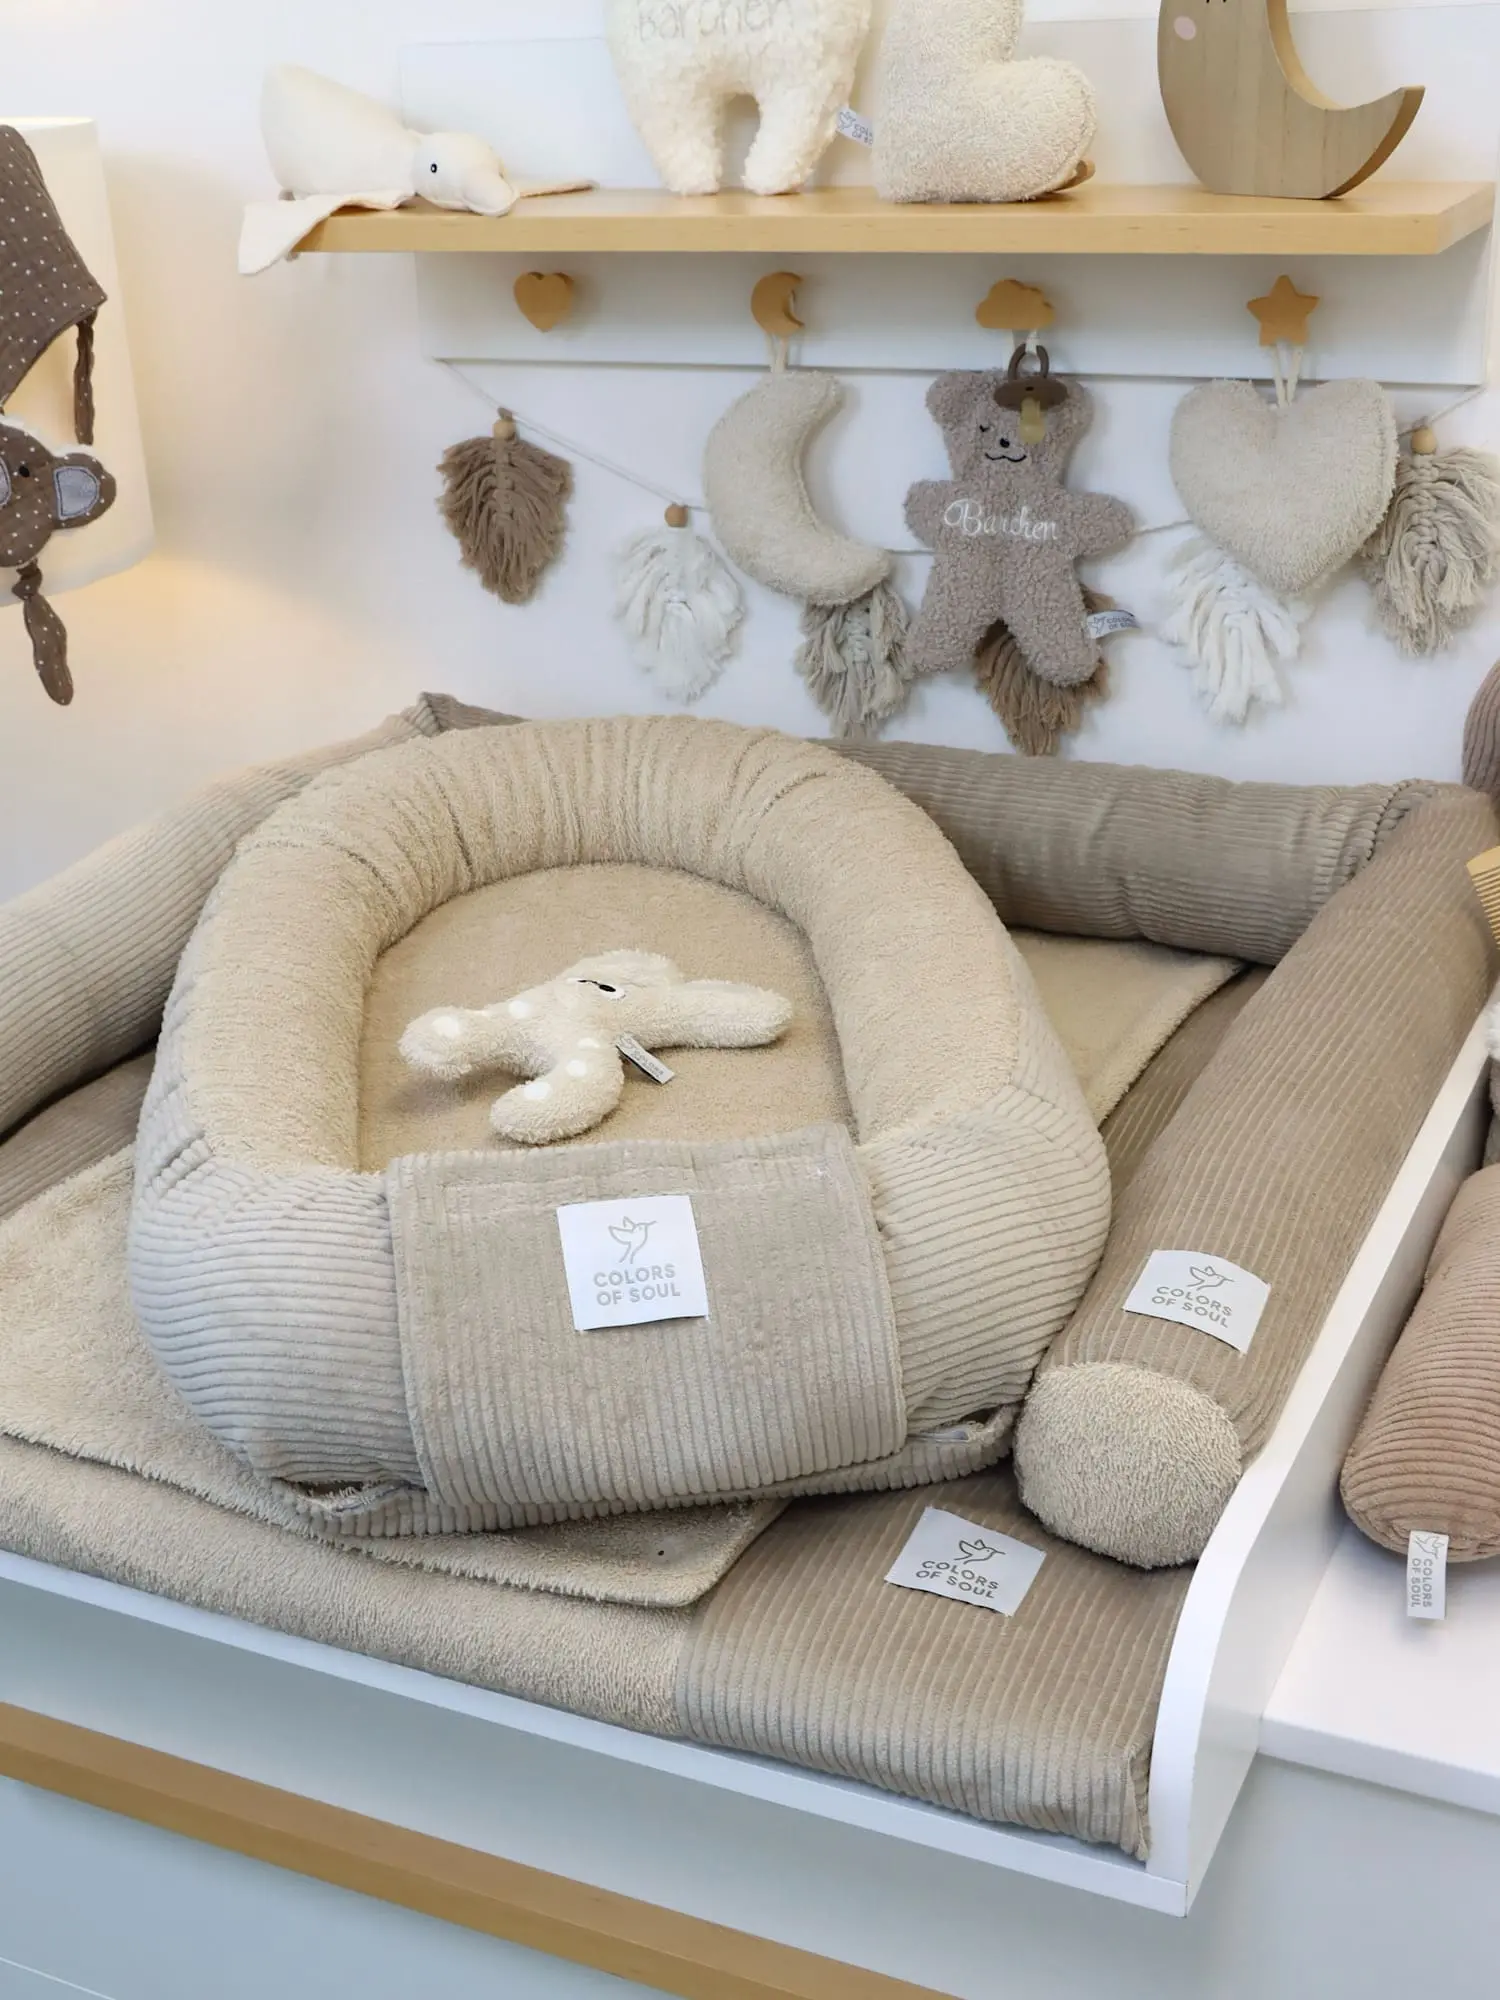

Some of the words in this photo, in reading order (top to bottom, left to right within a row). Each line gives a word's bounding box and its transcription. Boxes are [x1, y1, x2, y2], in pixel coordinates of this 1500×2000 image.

[592, 1263, 677, 1288] COLORS
[596, 1289, 624, 1307] OF
[629, 1281, 681, 1304] SOUL
[1155, 1285, 1233, 1317] COLORS
[1150, 1295, 1177, 1307] OF
[1180, 1302, 1229, 1329] SOUL
[921, 1560, 1000, 1590] COLORS
[1412, 1557, 1422, 1574] OF
[915, 1570, 943, 1580] OF
[946, 1576, 996, 1599] SOUL
[1410, 1576, 1422, 1608] SOUL
[1422, 1558, 1434, 1608] COLORS
